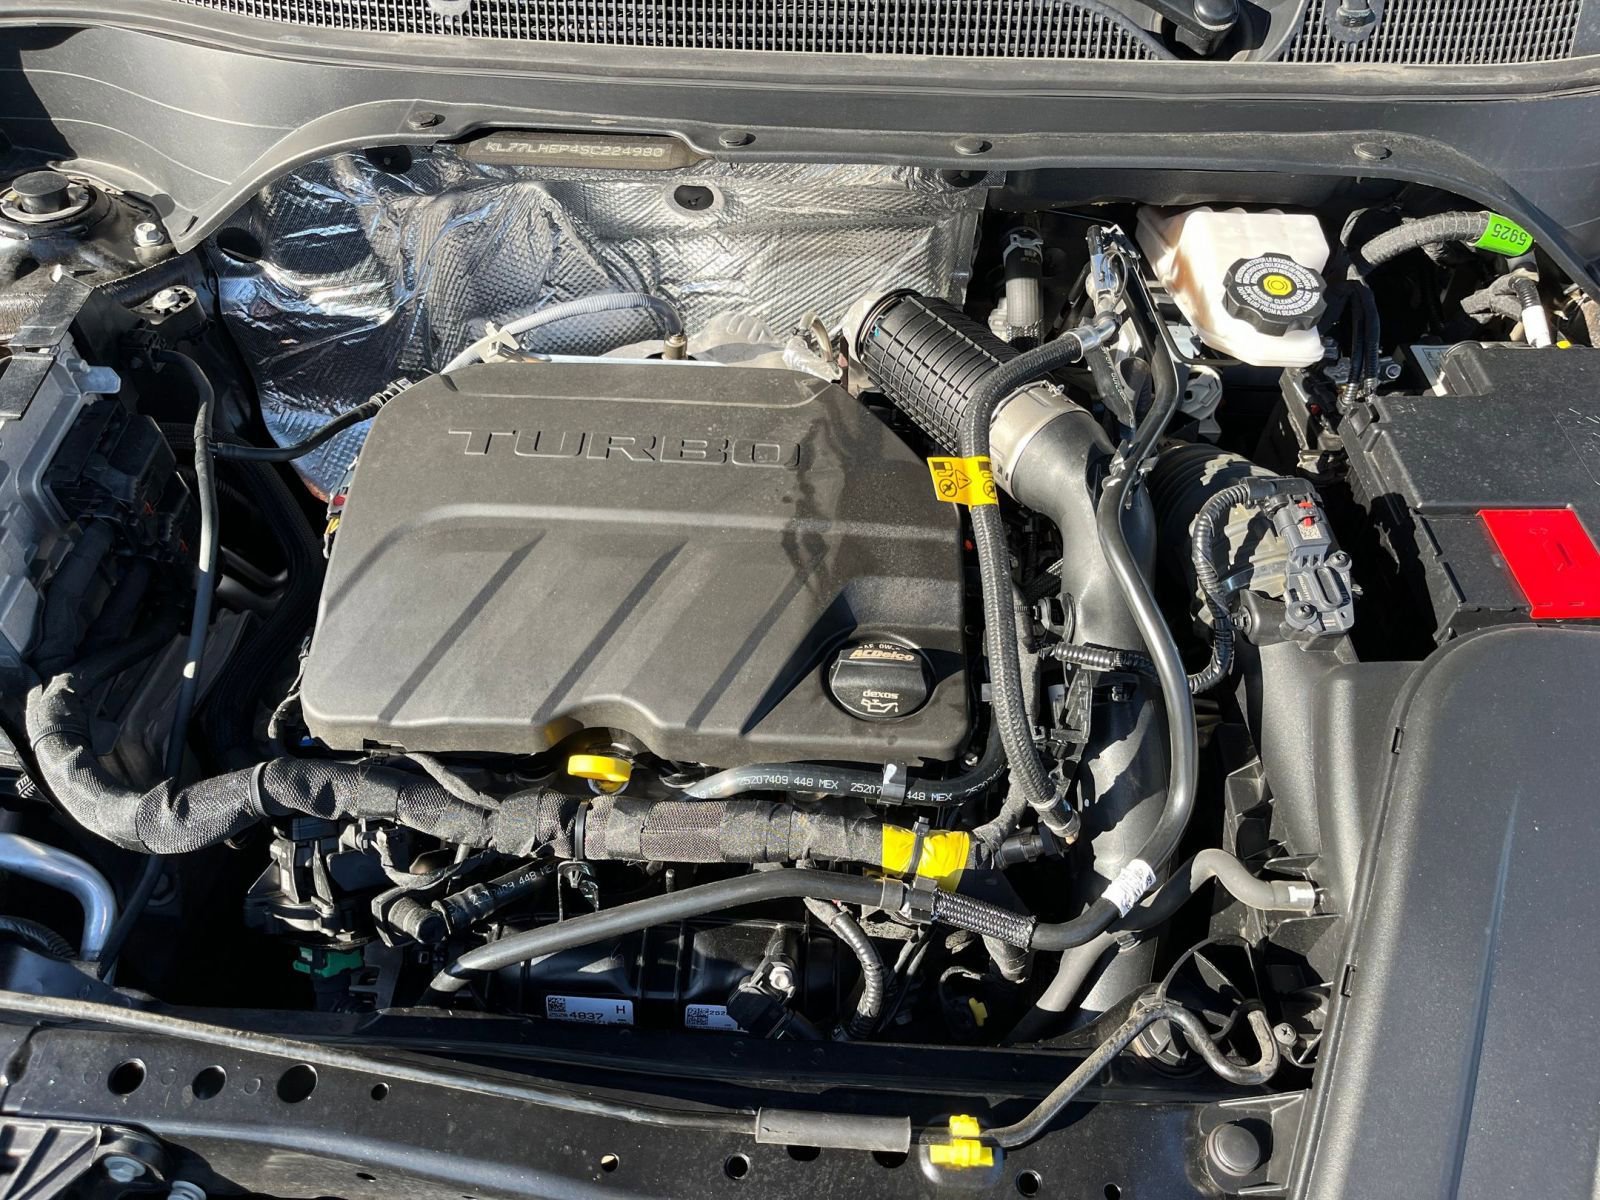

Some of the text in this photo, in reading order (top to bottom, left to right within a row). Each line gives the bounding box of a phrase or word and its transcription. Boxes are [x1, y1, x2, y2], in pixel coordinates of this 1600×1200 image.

[1491, 223, 1528, 246] 5925
[448, 430, 800, 468] TURBO
[848, 649, 915, 661] ACDelco
[863, 690, 899, 699] dexos
[794, 776, 814, 787] 448
[819, 779, 839, 790] MEX
[931, 792, 953, 802] MEX
[519, 871, 537, 885] 448
[569, 1012, 604, 1020] 4837
[616, 1005, 625, 1014] H
